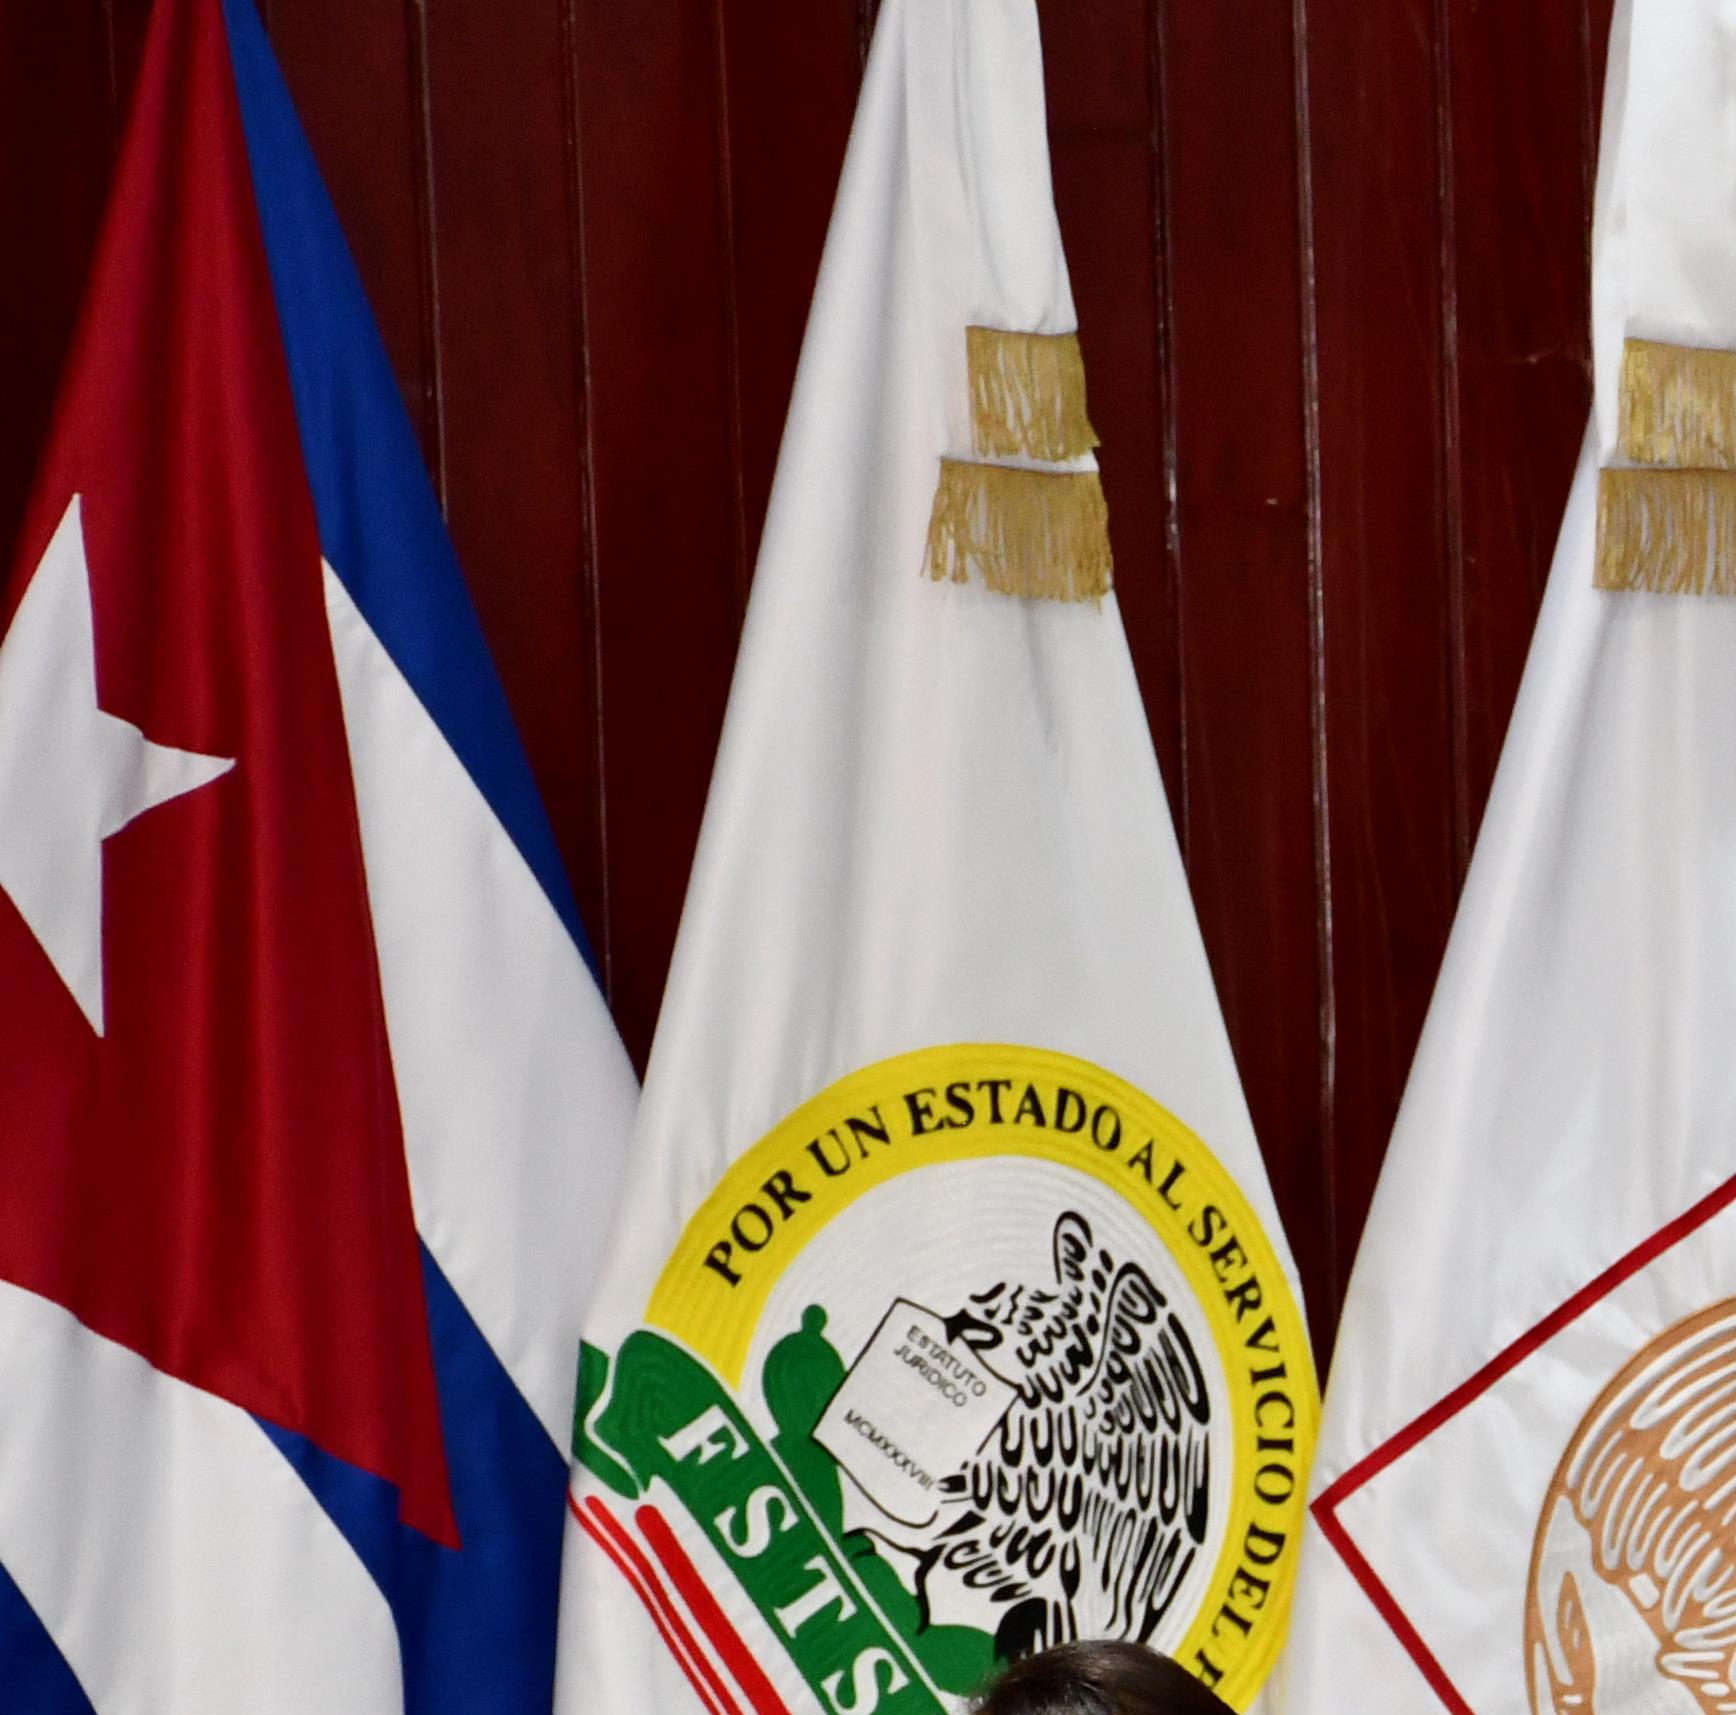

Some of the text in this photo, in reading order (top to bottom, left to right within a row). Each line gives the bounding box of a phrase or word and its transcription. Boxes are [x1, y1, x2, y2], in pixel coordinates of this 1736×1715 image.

[703, 1079, 1295, 1640] POR UN ESTADO AL SERVICIO DEL
[893, 1344, 968, 1408] JURIDICO
[906, 1325, 986, 1398] ESTATUTO
